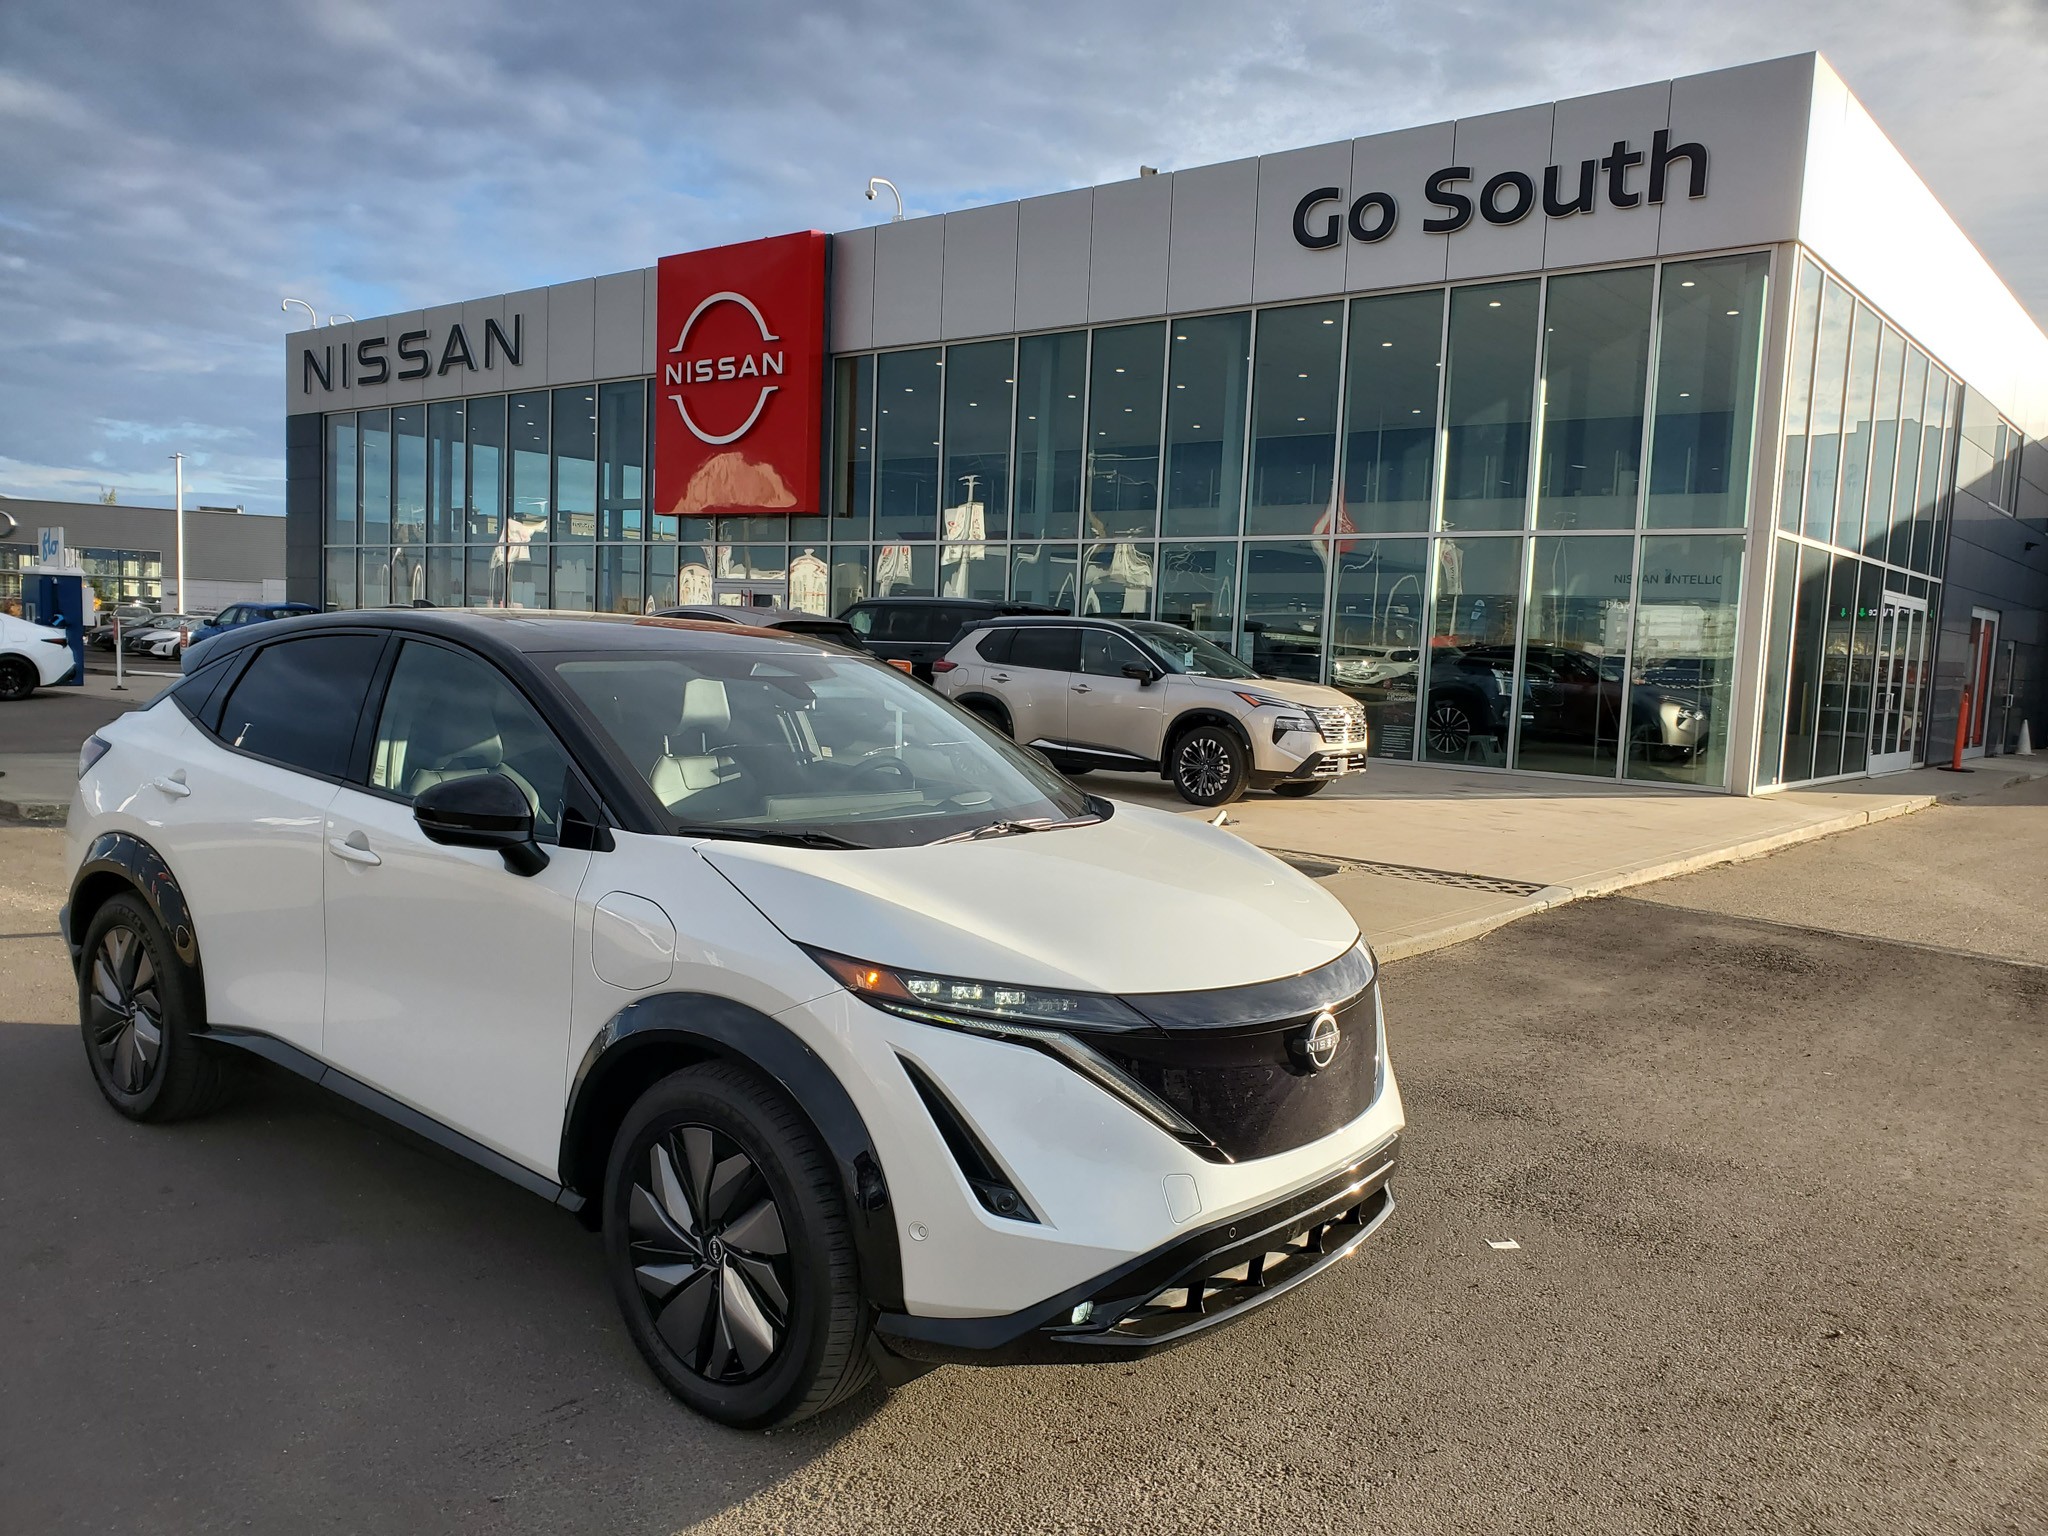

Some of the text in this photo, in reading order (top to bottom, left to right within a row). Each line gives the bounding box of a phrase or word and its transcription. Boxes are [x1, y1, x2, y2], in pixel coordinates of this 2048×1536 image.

[1293, 128, 1710, 251] Go South
[303, 313, 524, 395] NISSAN
[665, 350, 784, 386] NISSAN
[42, 528, 58, 562] flo
[1614, 574, 1659, 584] NISAN
